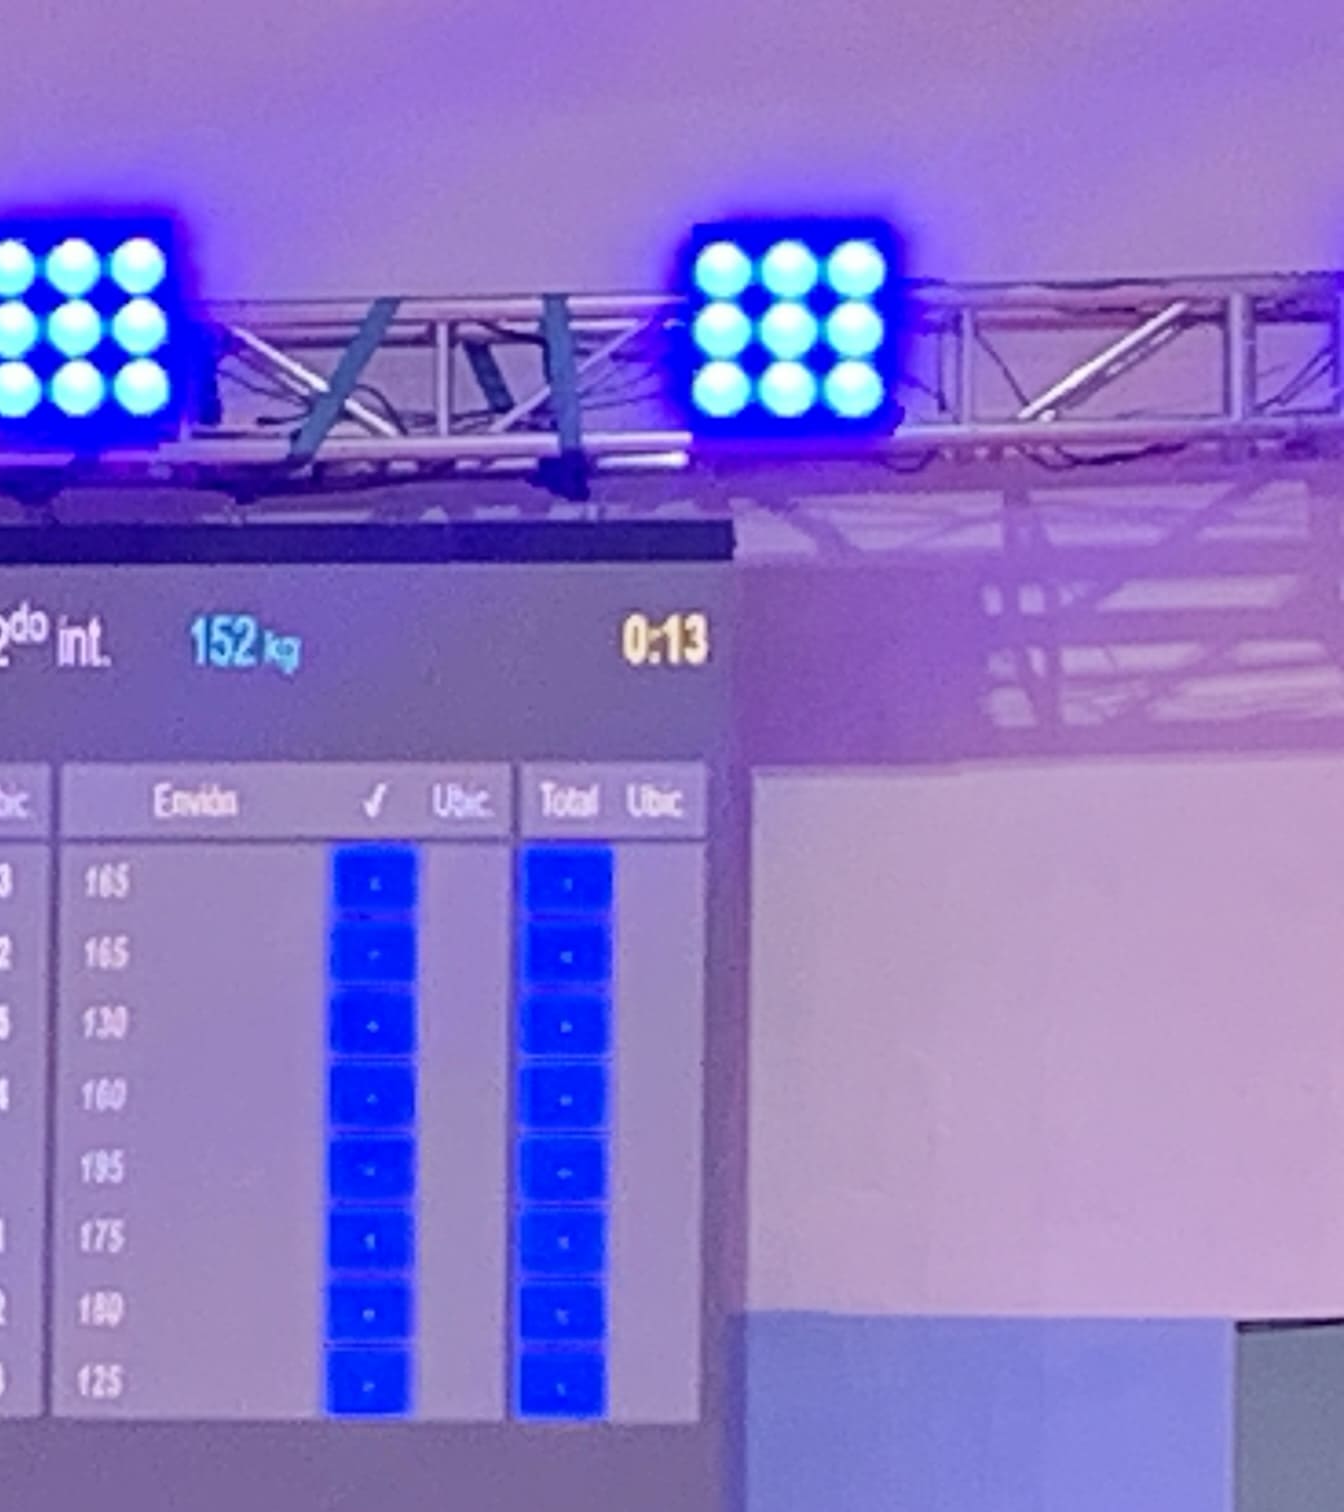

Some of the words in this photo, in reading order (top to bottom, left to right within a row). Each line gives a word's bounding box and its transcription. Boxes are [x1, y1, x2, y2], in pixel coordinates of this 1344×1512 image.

[56, 615, 113, 668] int.
[190, 615, 255, 667] 152
[263, 630, 301, 675] kg
[622, 615, 709, 666] 0:13
[540, 783, 599, 818] Total
[79, 1220, 125, 1254] 175
